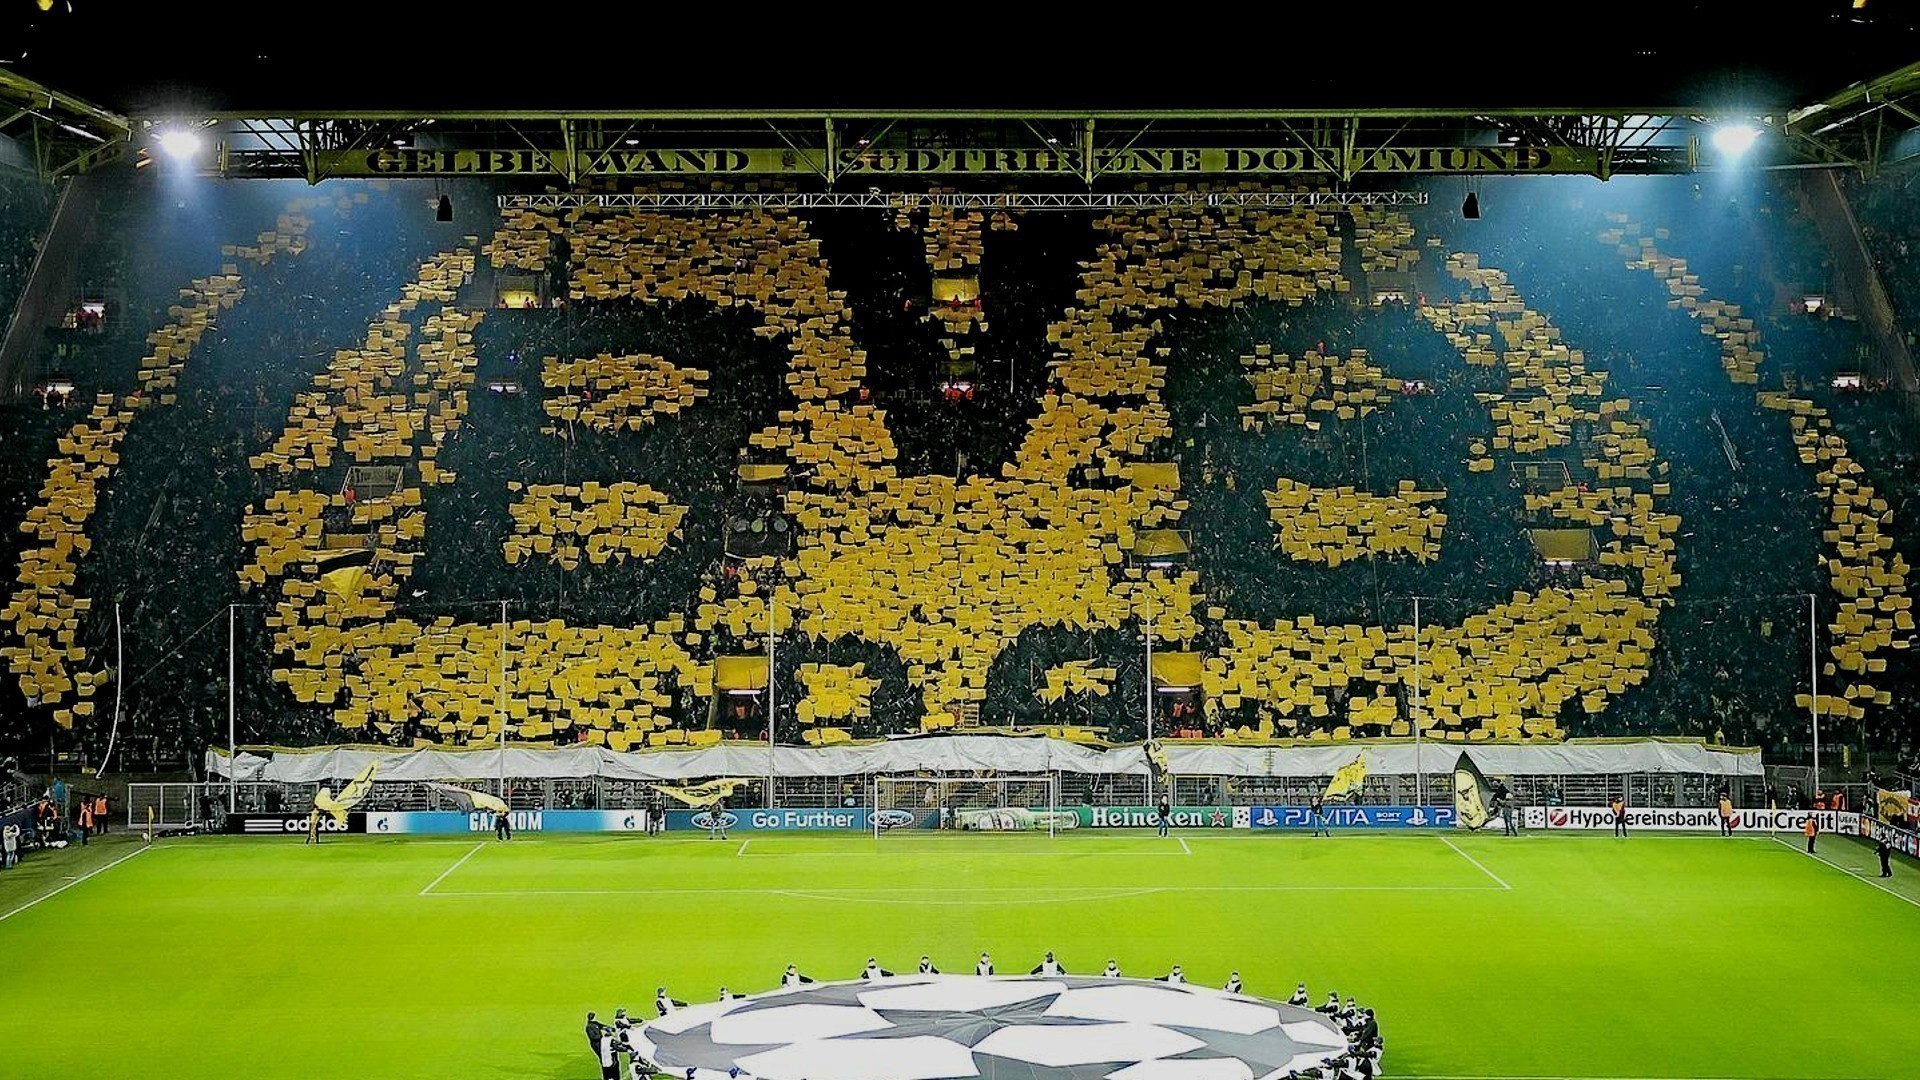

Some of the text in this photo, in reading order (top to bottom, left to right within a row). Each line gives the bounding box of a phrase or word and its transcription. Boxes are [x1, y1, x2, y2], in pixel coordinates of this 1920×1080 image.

[366, 148, 1553, 173] GELBE WAND SÜDTRIBÜNE DORTMUND
[285, 814, 349, 832] addas
[469, 812, 543, 831] GAZROM
[752, 810, 855, 828] Go Further
[1570, 809, 1718, 828] Hypoereinsbank
